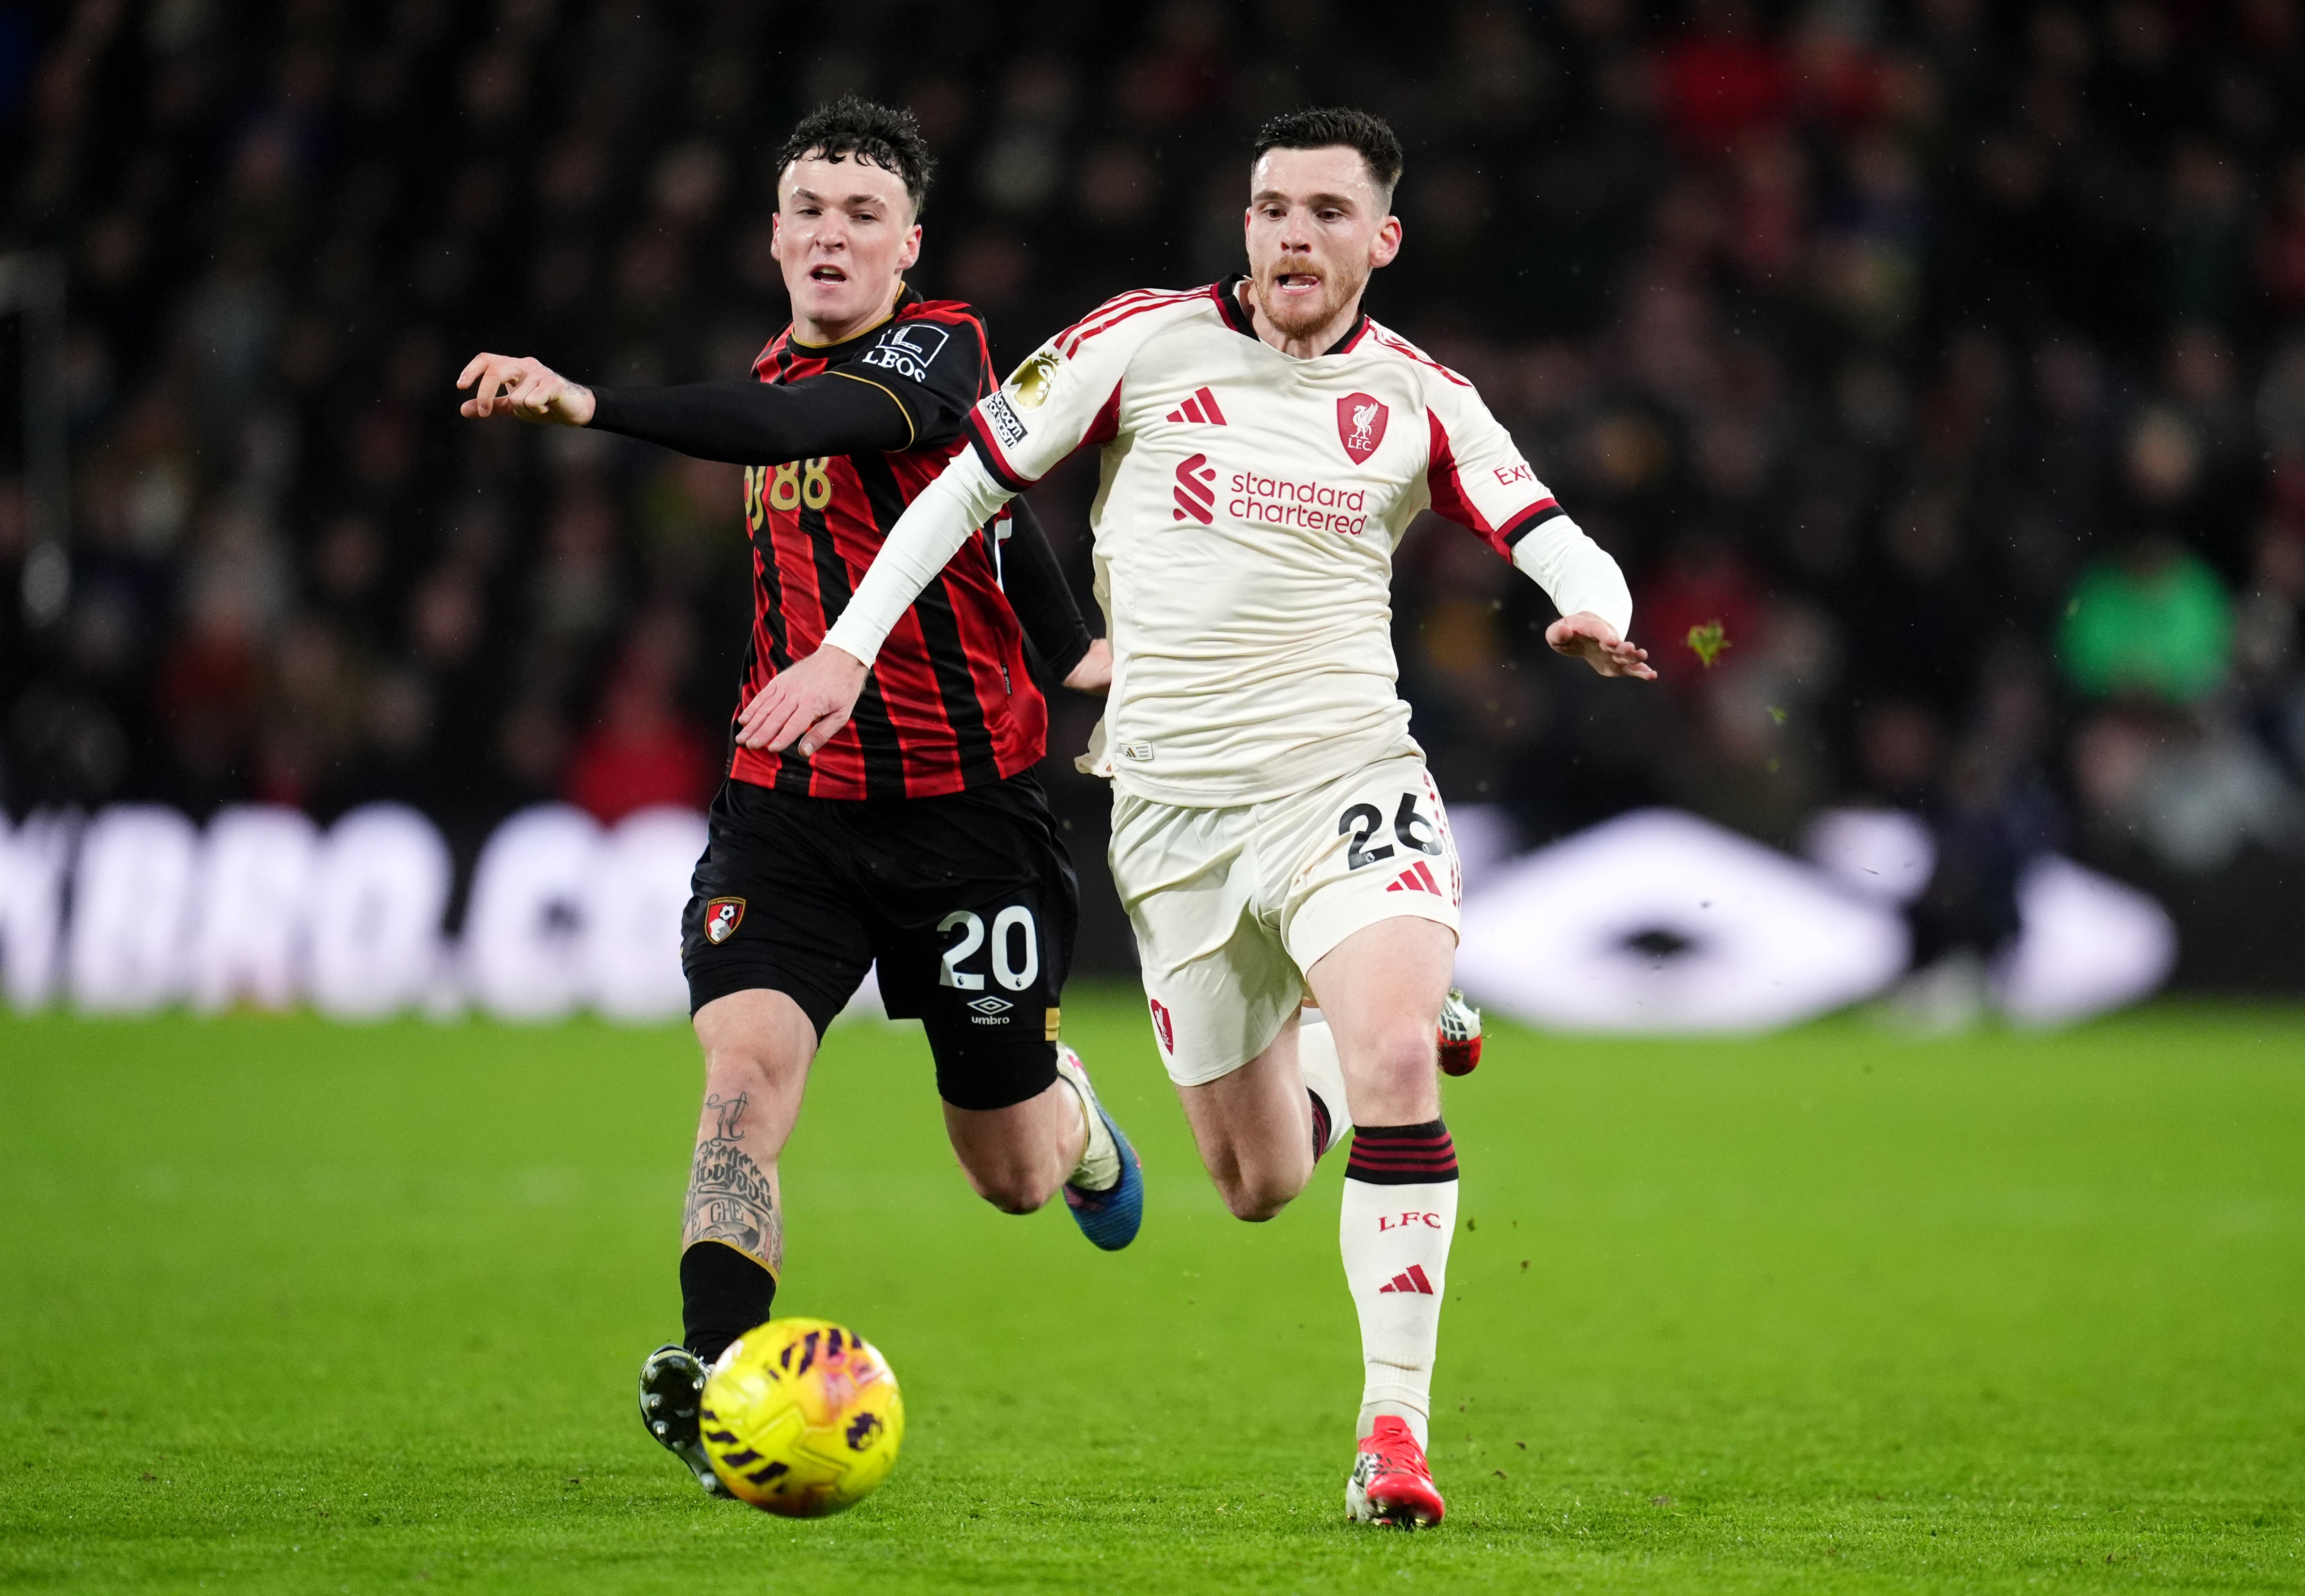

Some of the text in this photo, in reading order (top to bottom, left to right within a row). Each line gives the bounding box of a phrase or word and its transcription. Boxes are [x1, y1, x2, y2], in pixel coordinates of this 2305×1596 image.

[996, 412, 1017, 449] racism
[1000, 404, 1023, 438] room
[1231, 472, 1365, 511] standard
[1230, 496, 1367, 535] chartered
[1339, 793, 1443, 870] 26
[937, 906, 1038, 991] 20
[972, 1016, 1010, 1025] umbro
[1379, 1212, 1441, 1232] LFC
